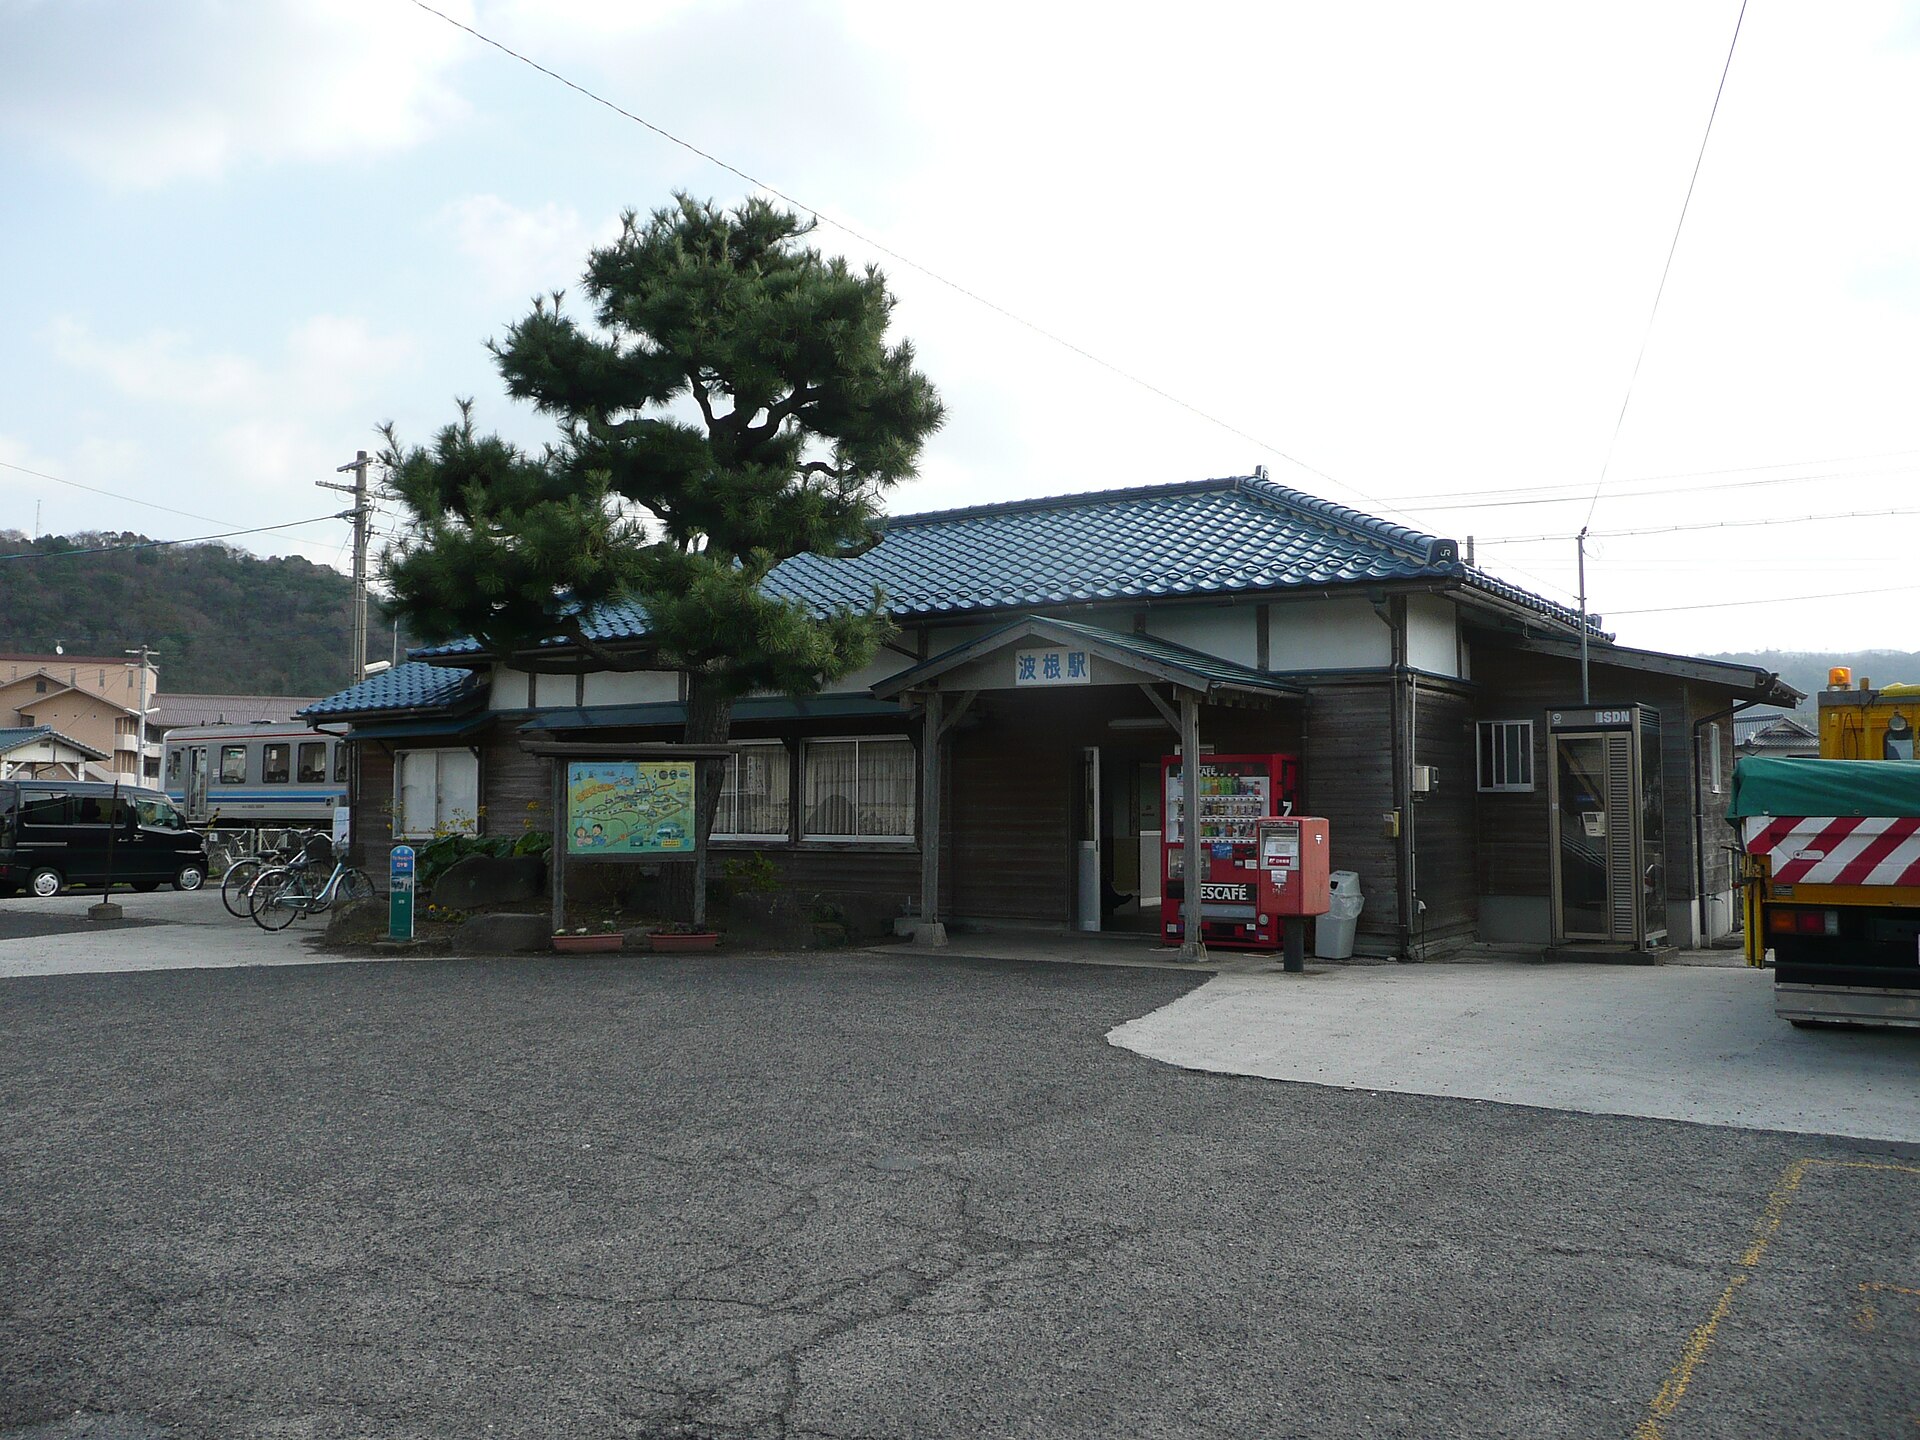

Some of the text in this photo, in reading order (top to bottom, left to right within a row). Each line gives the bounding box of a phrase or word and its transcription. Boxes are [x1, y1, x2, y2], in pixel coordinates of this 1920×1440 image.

[1440, 549, 1451, 557] JR
[1018, 651, 1087, 680] 波根駅
[1594, 710, 1630, 723] ISDN
[1200, 883, 1248, 900] ESCAFÉ
